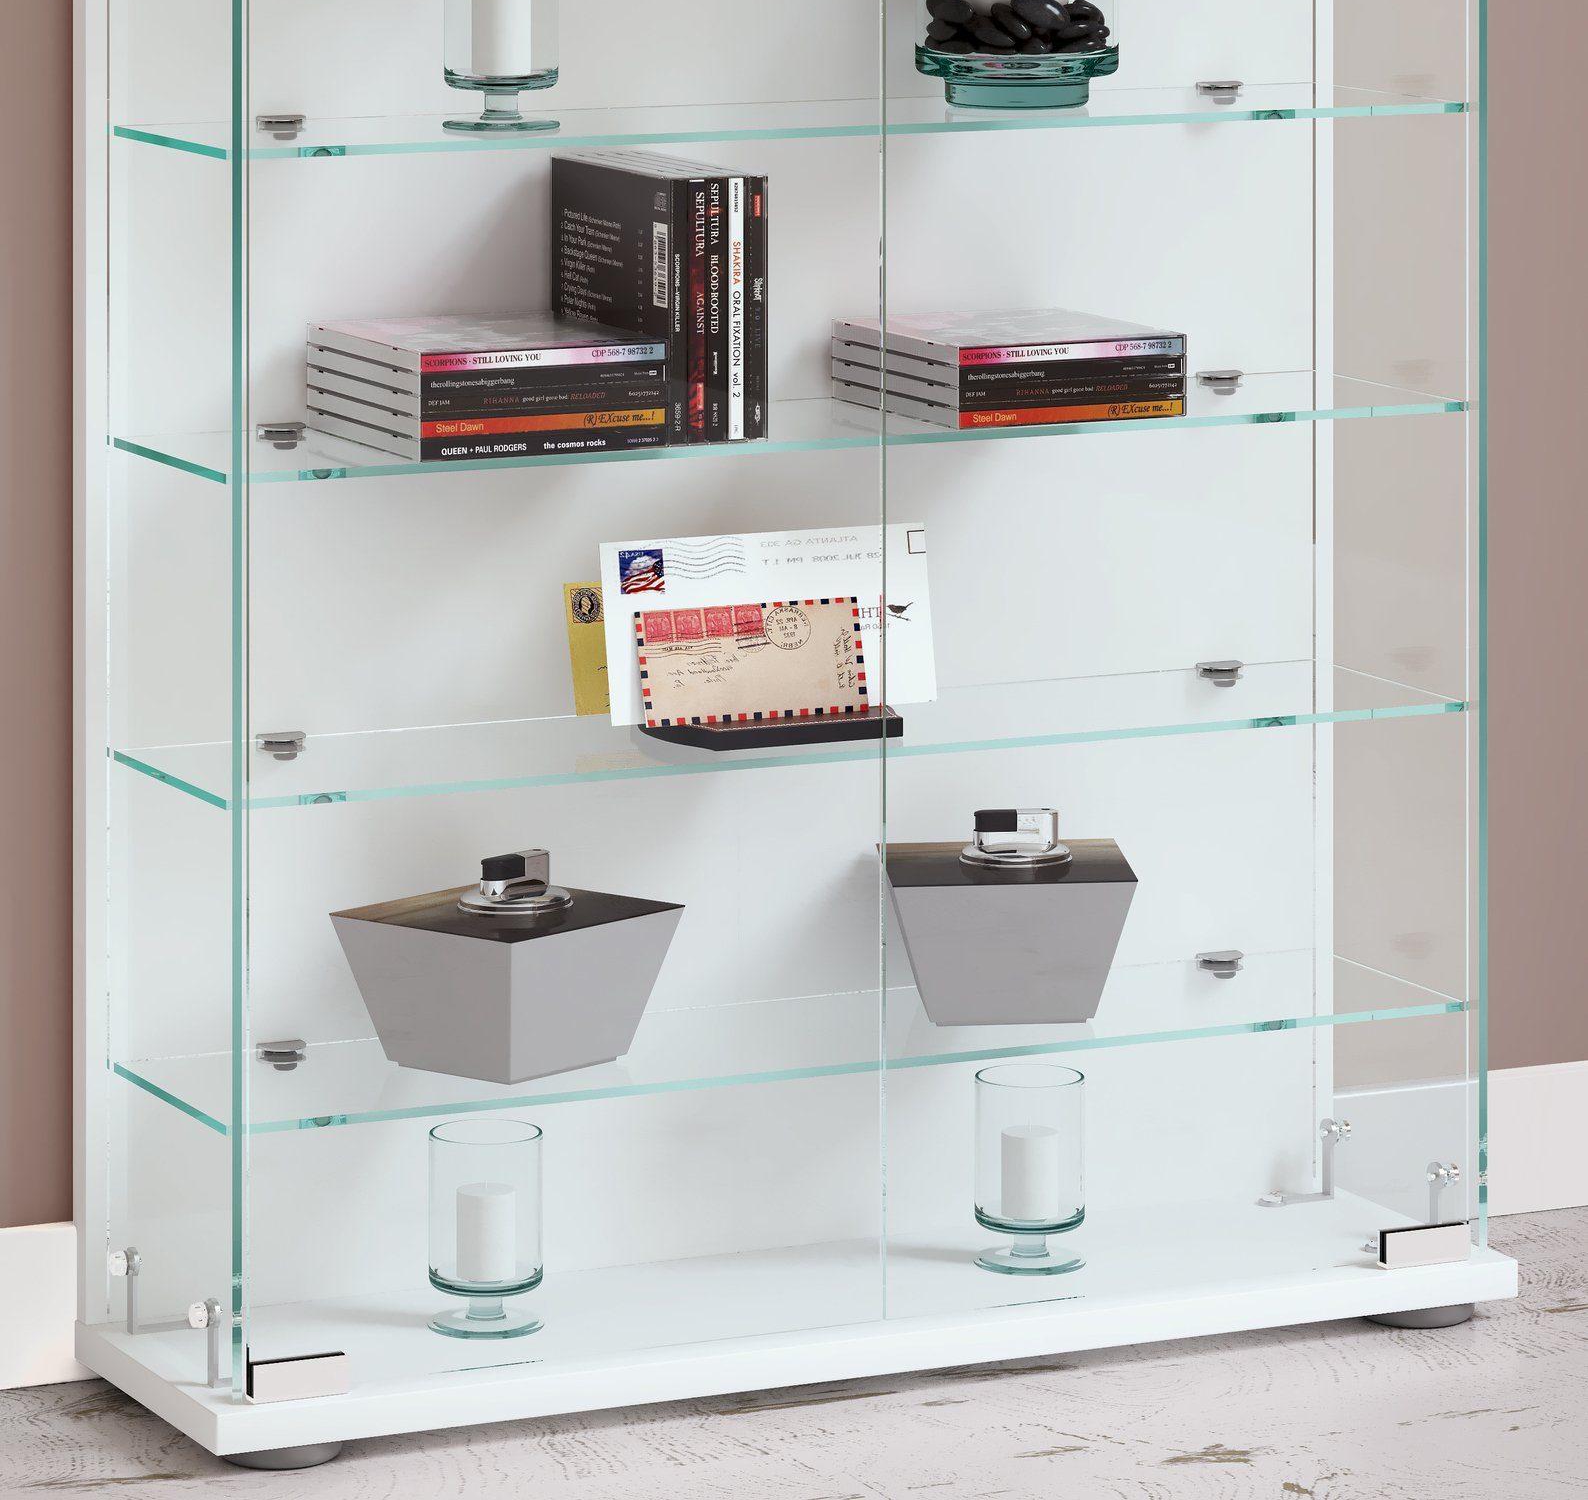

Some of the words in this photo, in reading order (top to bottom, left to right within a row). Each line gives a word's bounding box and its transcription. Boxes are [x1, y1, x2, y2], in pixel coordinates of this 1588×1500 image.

[710, 183, 720, 245] SEPULTURA
[696, 192, 705, 258] SEPULTURA
[732, 241, 742, 285] SHAKIRA
[732, 290, 742, 318] ORAL
[696, 291, 704, 334] AGAINST
[732, 320, 741, 367] FIXATION
[1115, 343, 1128, 352] CDP
[1130, 342, 1147, 350] 568-7
[1148, 342, 1166, 350] 98732
[424, 357, 468, 368] SCORPIONS
[472, 356, 493, 365] STILL
[494, 354, 524, 364] LOVING
[524, 352, 542, 362] YOU
[592, 349, 606, 358] CDP
[607, 348, 626, 358] 568-7
[627, 347, 648, 356] 98732
[962, 350, 1002, 360] SCORPIONS
[1006, 349, 1026, 358] STILL
[1026, 348, 1053, 357] LOVING
[1054, 346, 1069, 355] YOU
[430, 376, 515, 389] therollingstonesabiggerbang
[732, 372, 741, 389] vol.
[1016, 388, 1050, 396] RIHANNA
[1052, 387, 1064, 395] good
[1096, 382, 1128, 392] RELOADED
[483, 396, 520, 406] RIHANNA
[522, 396, 536, 404] good
[536, 394, 546, 402] girl
[570, 391, 606, 400] RELOADED
[1108, 405, 1121, 417] (R)
[1122, 404, 1150, 414] EXcuse
[1152, 402, 1174, 412] me...!
[583, 414, 598, 426] (R)
[600, 412, 630, 424] EXcuse
[633, 411, 655, 422] me...!
[972, 412, 994, 424] Steel
[994, 411, 1018, 422] Dawn
[436, 422, 458, 434] Steel
[460, 422, 484, 432] Dawn
[441, 447, 468, 456] QUEEN
[475, 446, 492, 454] PAUL
[494, 443, 527, 453] RODGERS
[544, 442, 556, 450] the
[557, 441, 585, 449] cosmos
[586, 438, 606, 448] rocks
